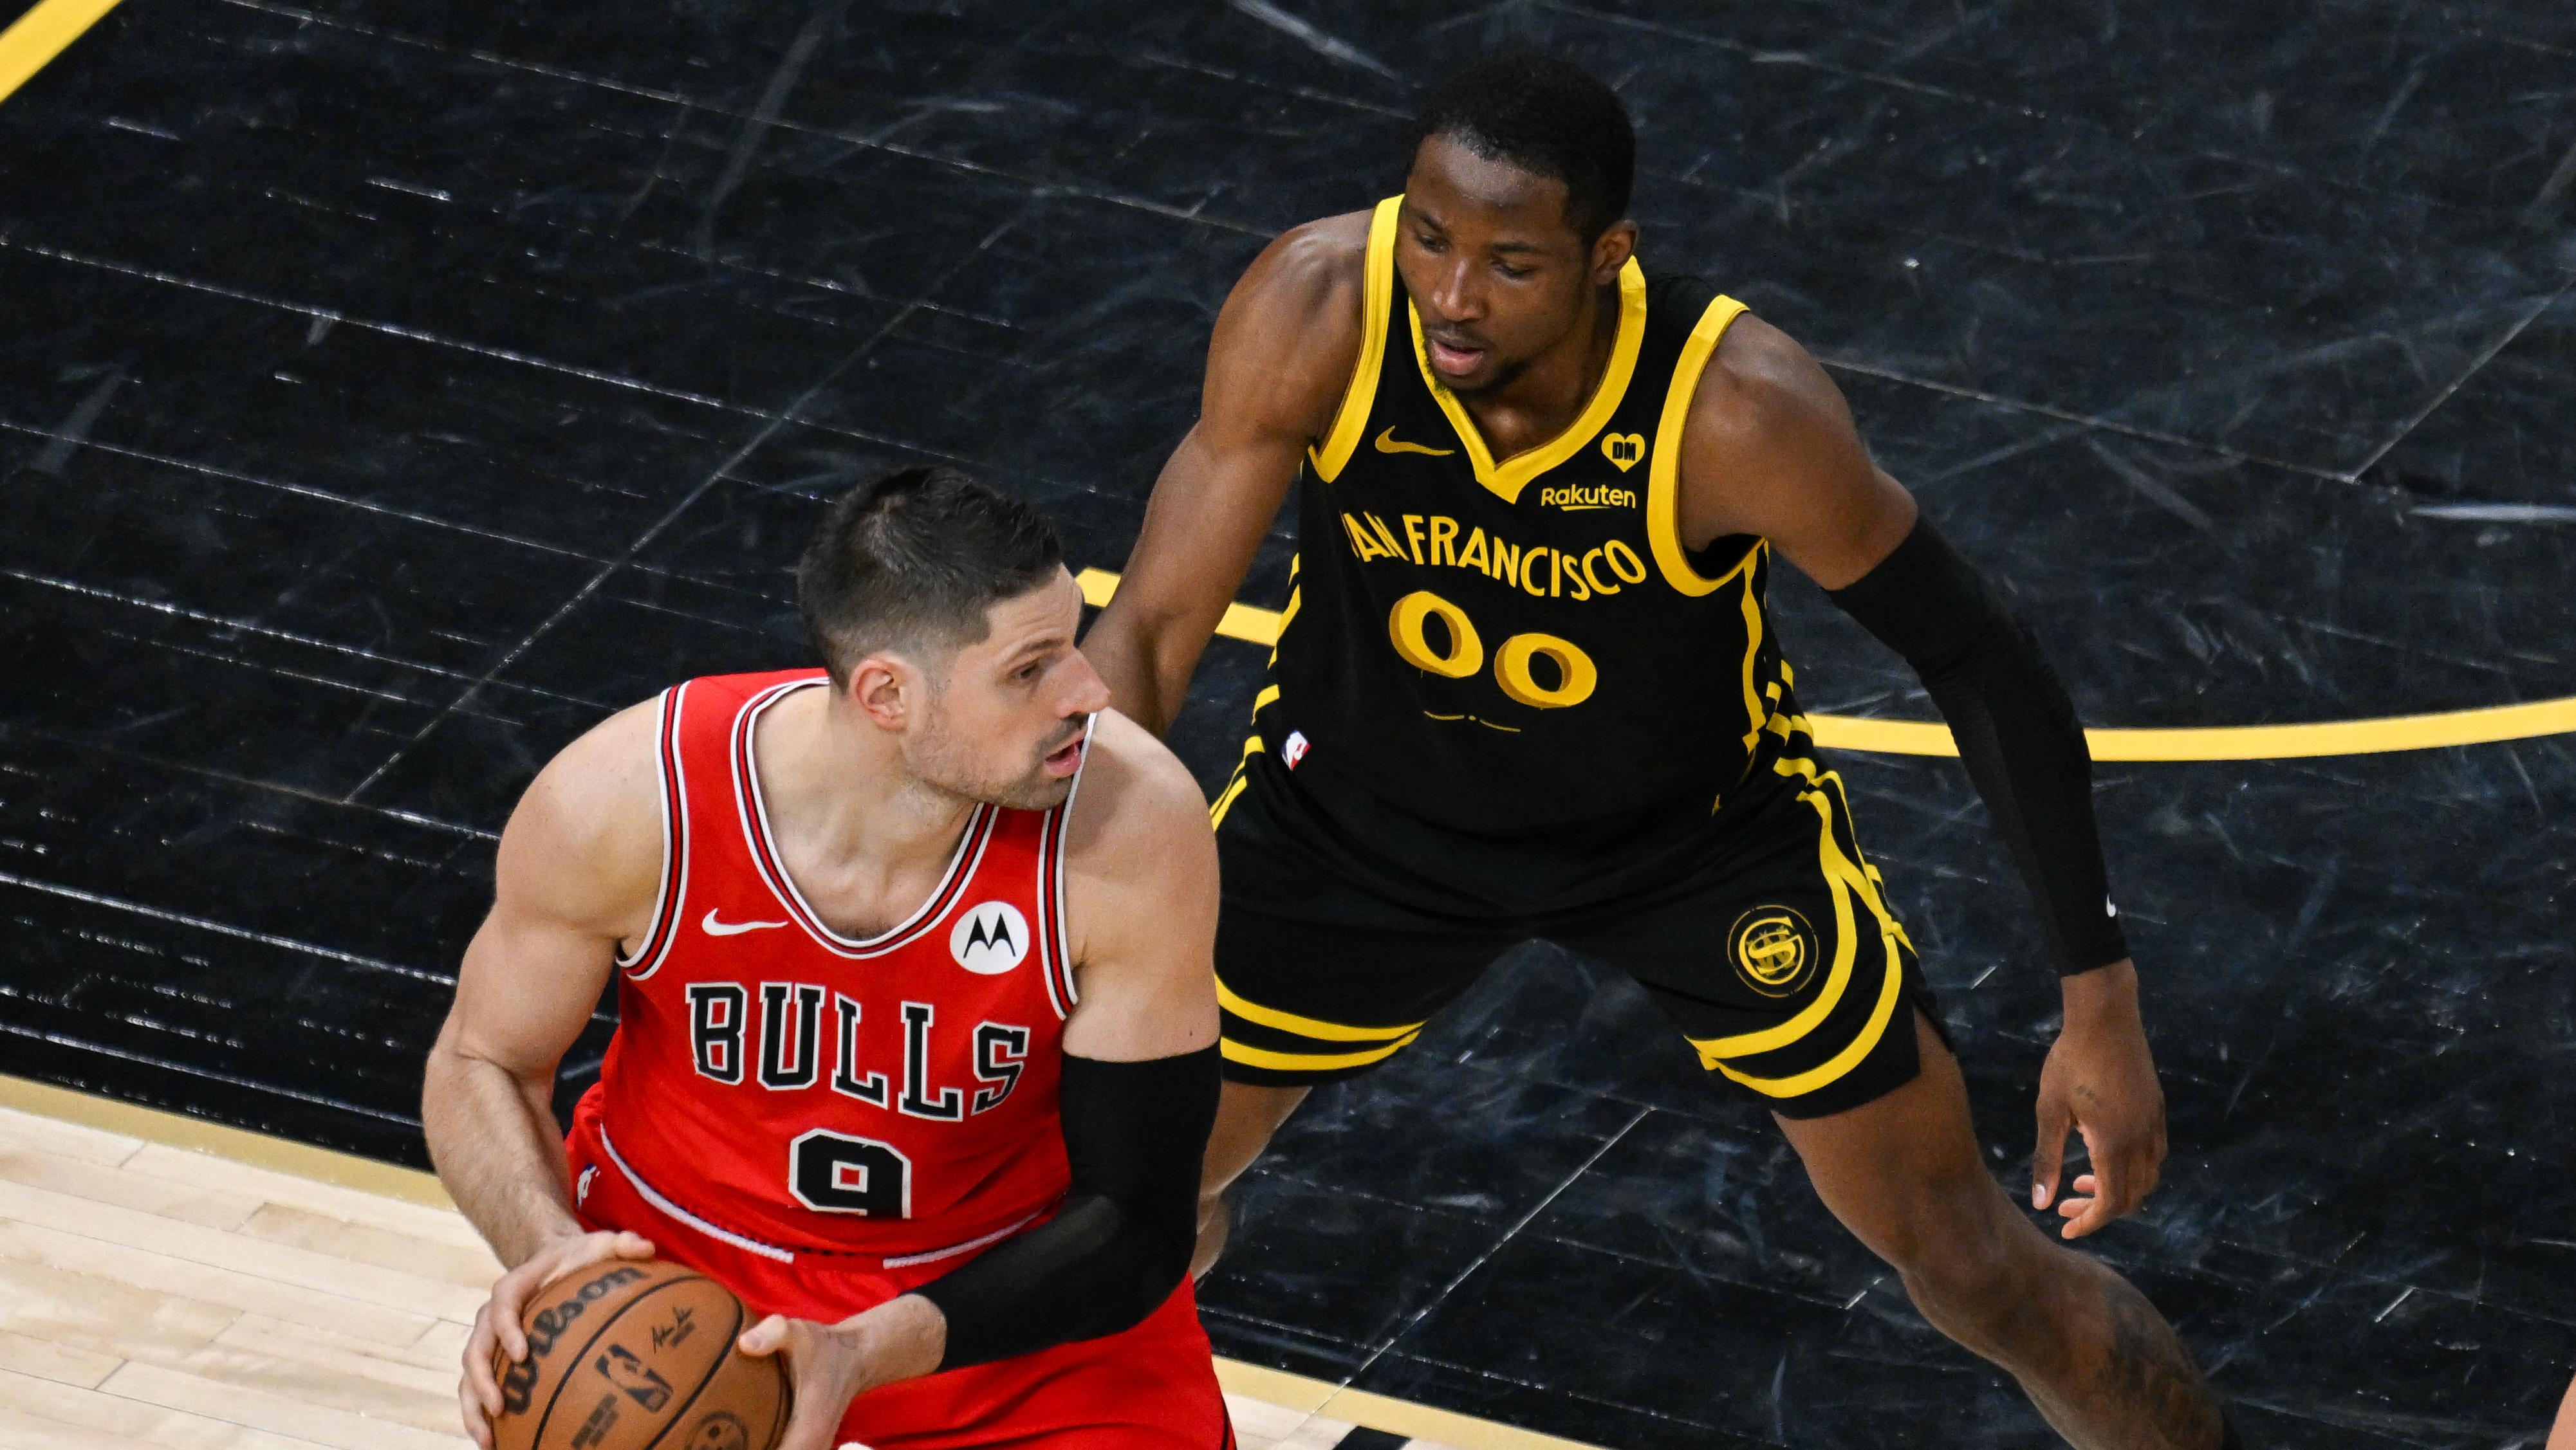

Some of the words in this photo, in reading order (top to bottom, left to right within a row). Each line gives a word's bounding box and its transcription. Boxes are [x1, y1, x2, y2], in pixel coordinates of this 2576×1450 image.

[1612, 441, 1636, 461] DM
[1541, 484, 1636, 511] Rakuten
[1339, 510, 1410, 563] AN
[1402, 513, 1647, 601] FRANCISCO
[1388, 590, 1598, 711] 00
[685, 981, 1031, 1122] BULLS
[788, 1128, 912, 1218] 9
